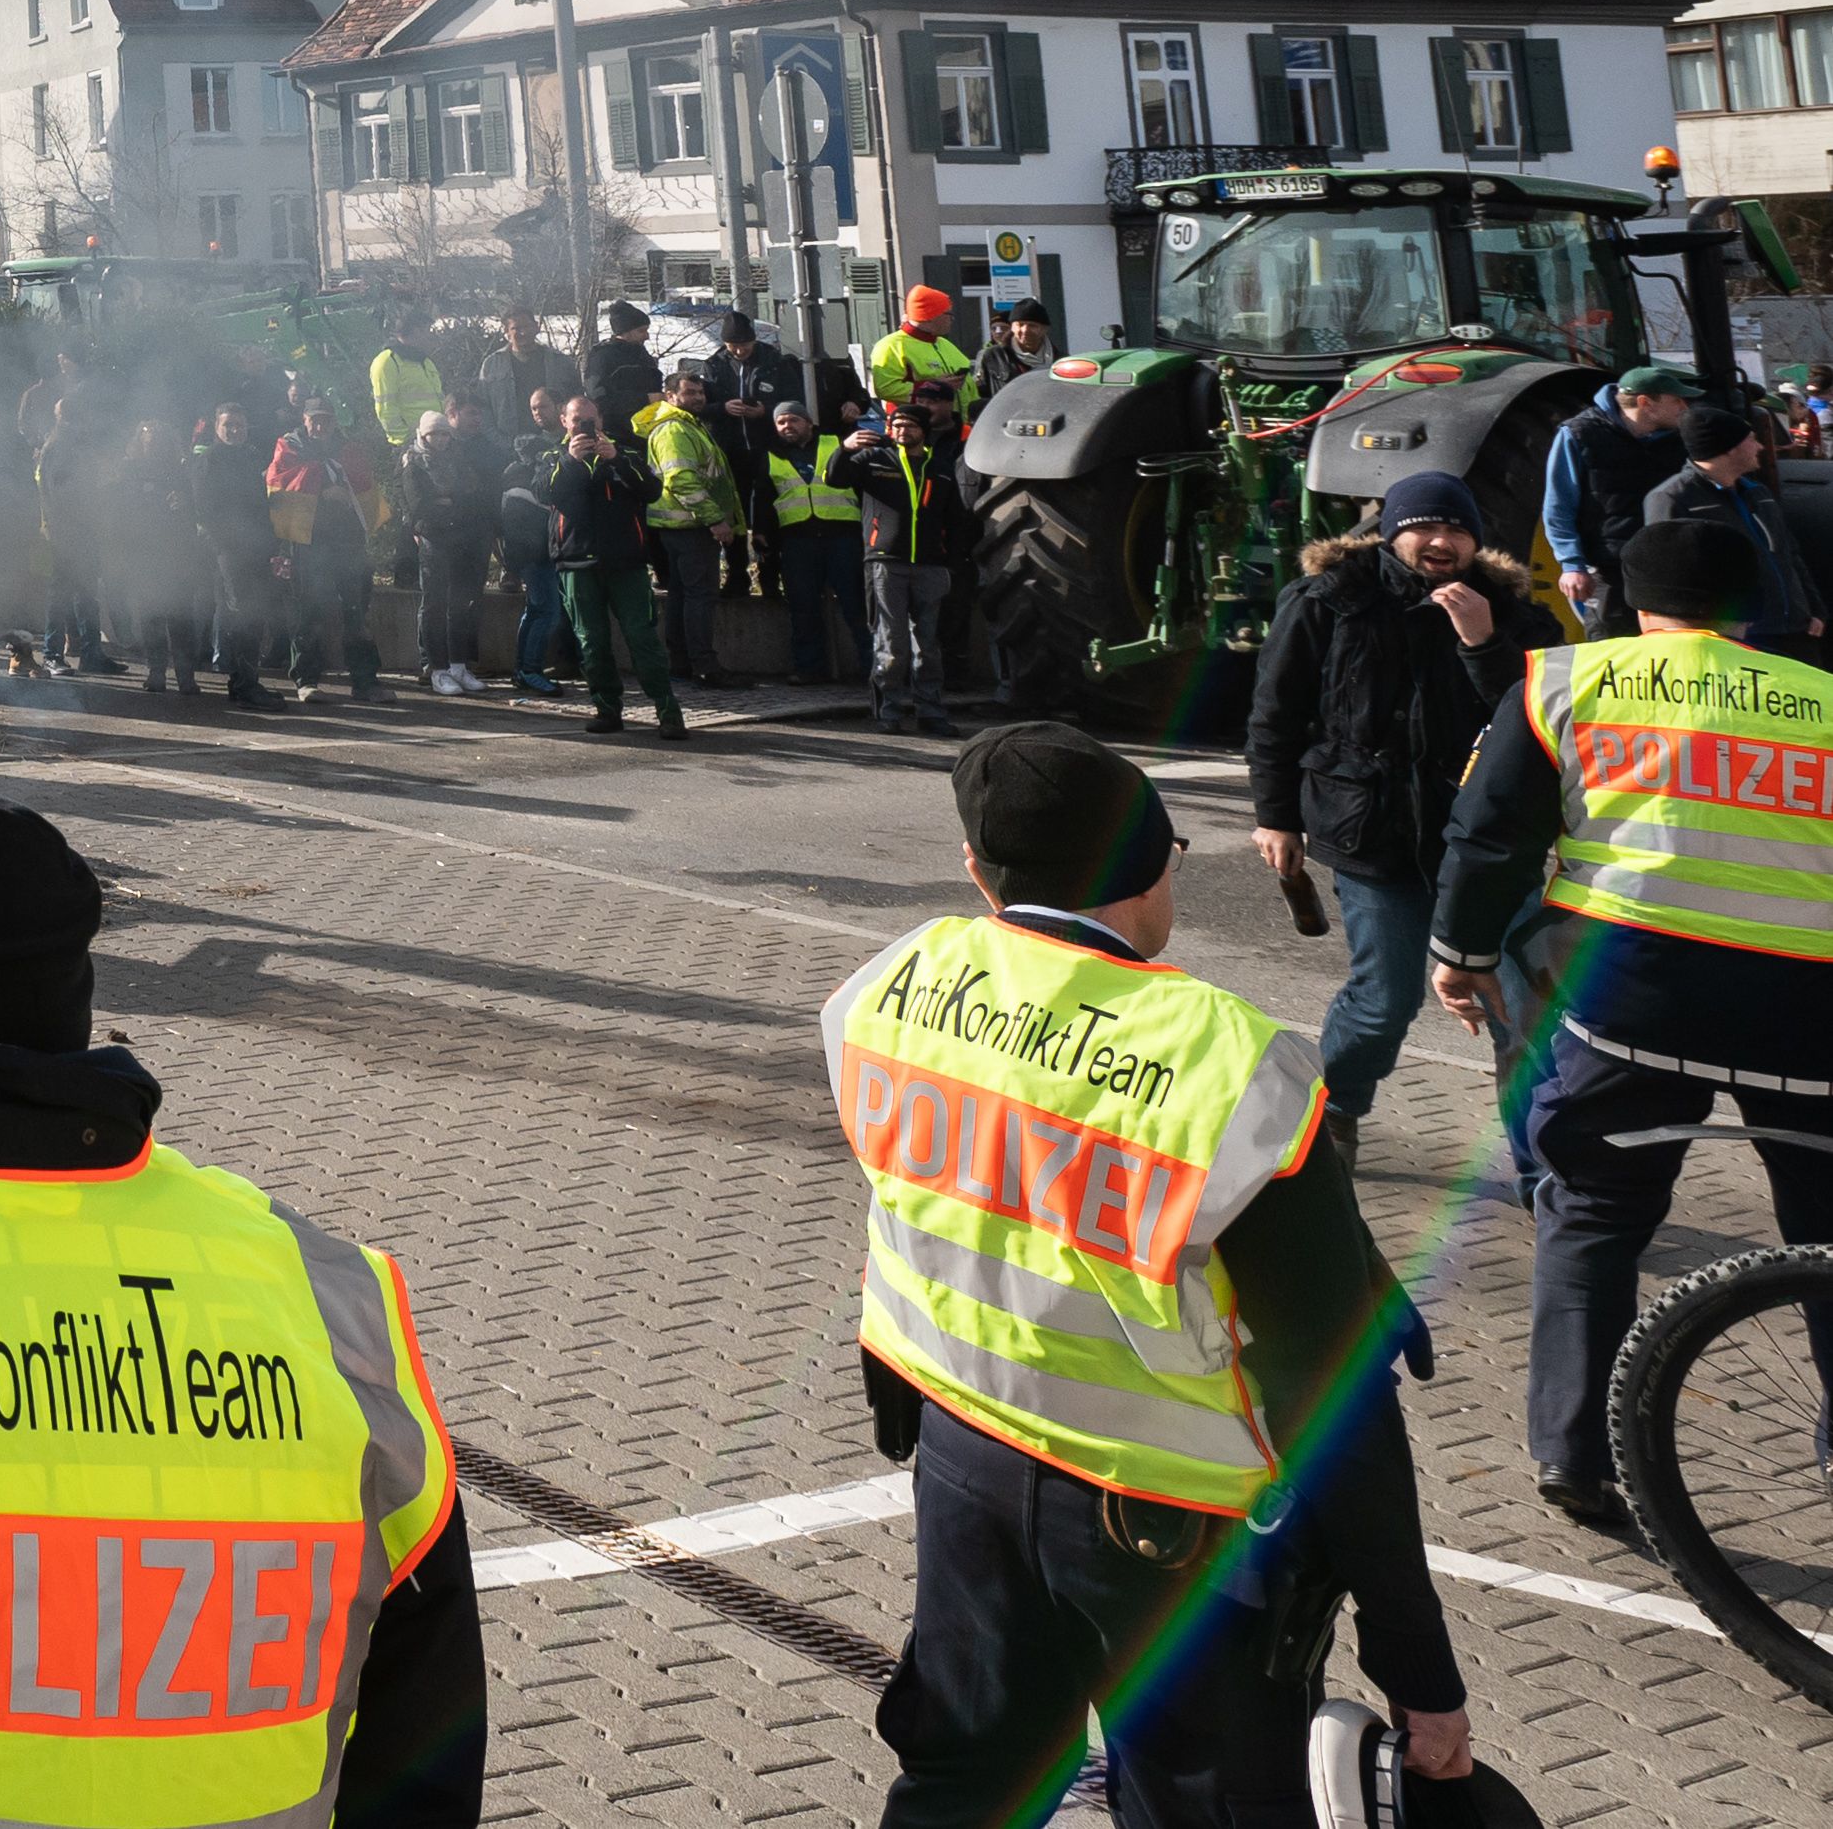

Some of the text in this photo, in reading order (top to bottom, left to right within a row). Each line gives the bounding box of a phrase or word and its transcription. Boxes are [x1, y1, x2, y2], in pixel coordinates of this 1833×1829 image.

[1267, 180, 1277, 194] S
[1280, 176, 1320, 193] 6185
[1172, 223, 1193, 246] 50
[1596, 657, 1823, 724] AntiKonfliktTeam
[876, 950, 1175, 1108] AntiKonfliktTeam
[855, 1059, 1173, 1267] POLIZEI
